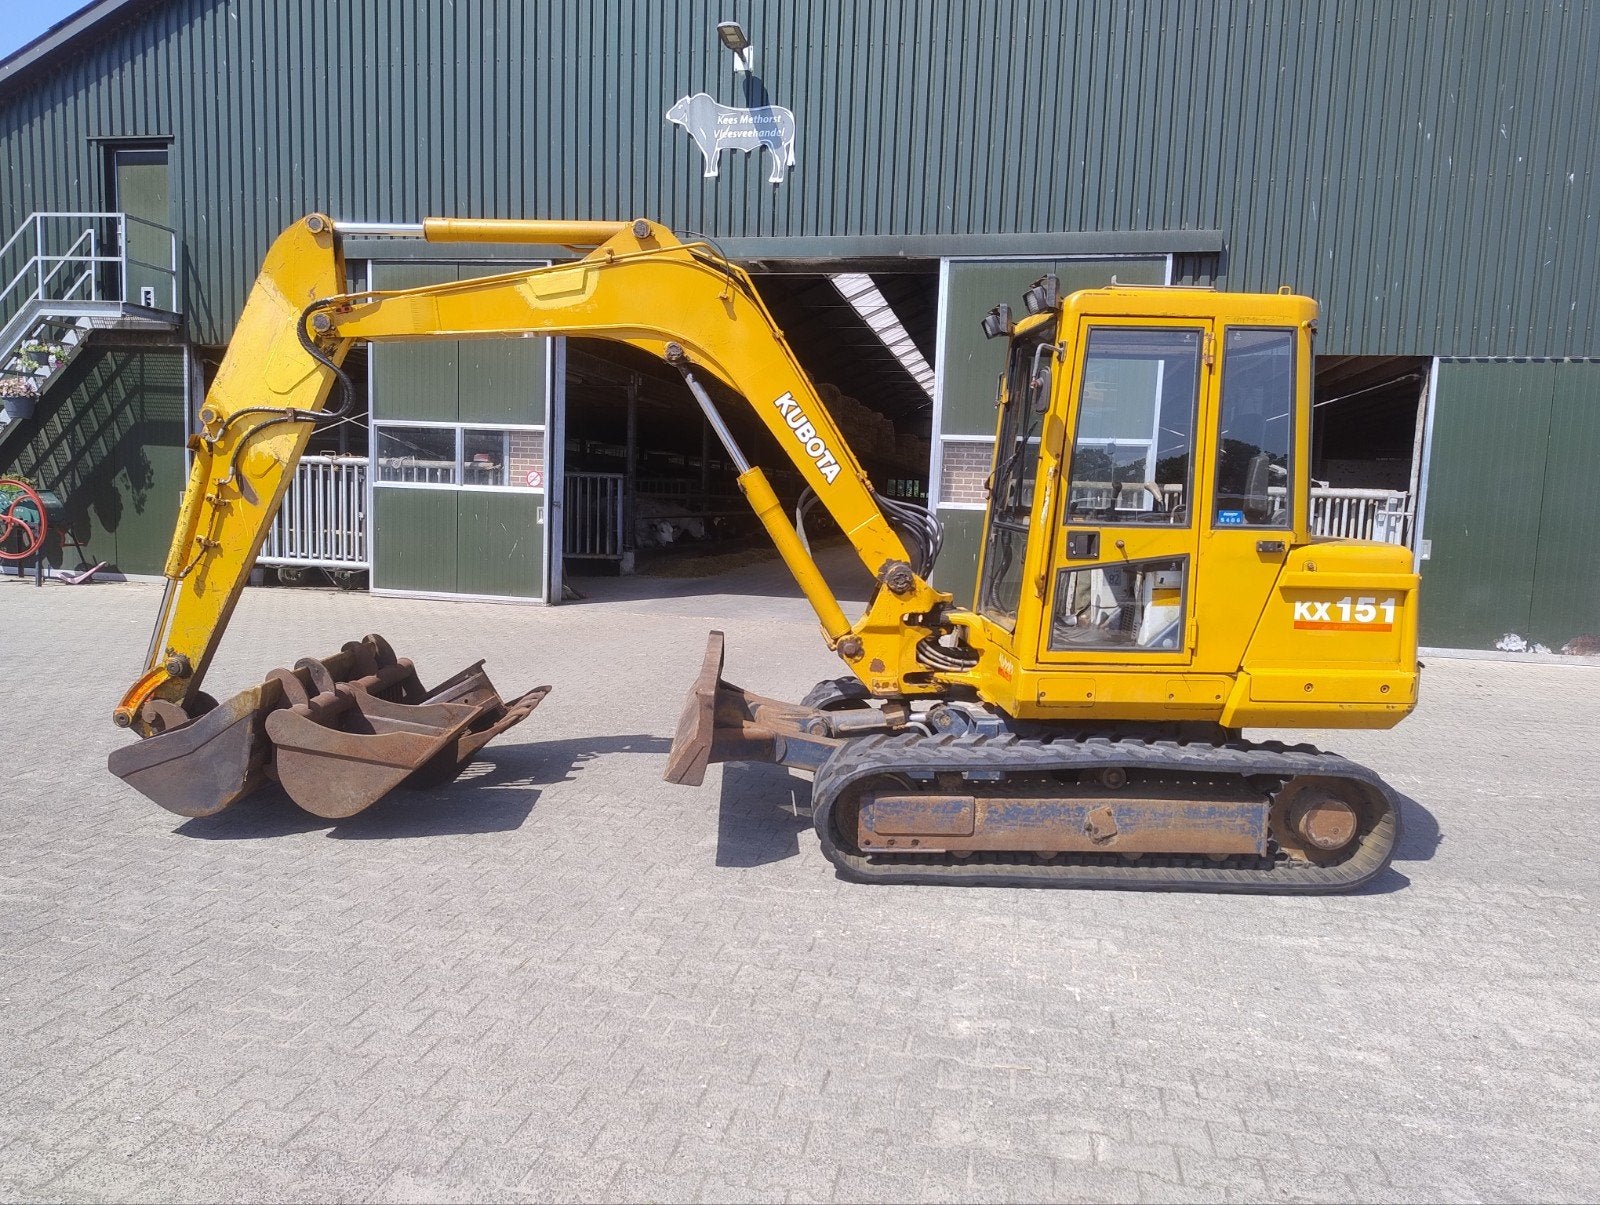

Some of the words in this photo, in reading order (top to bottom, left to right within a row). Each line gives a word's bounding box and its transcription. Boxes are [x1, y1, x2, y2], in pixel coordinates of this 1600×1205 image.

[717, 115, 738, 125] Kees
[739, 114, 782, 125] Methorst
[713, 127, 785, 139] Vleesveehandel
[773, 391, 842, 485] KUBOTA
[1293, 600, 1332, 621] KX
[1336, 596, 1396, 624] 151
